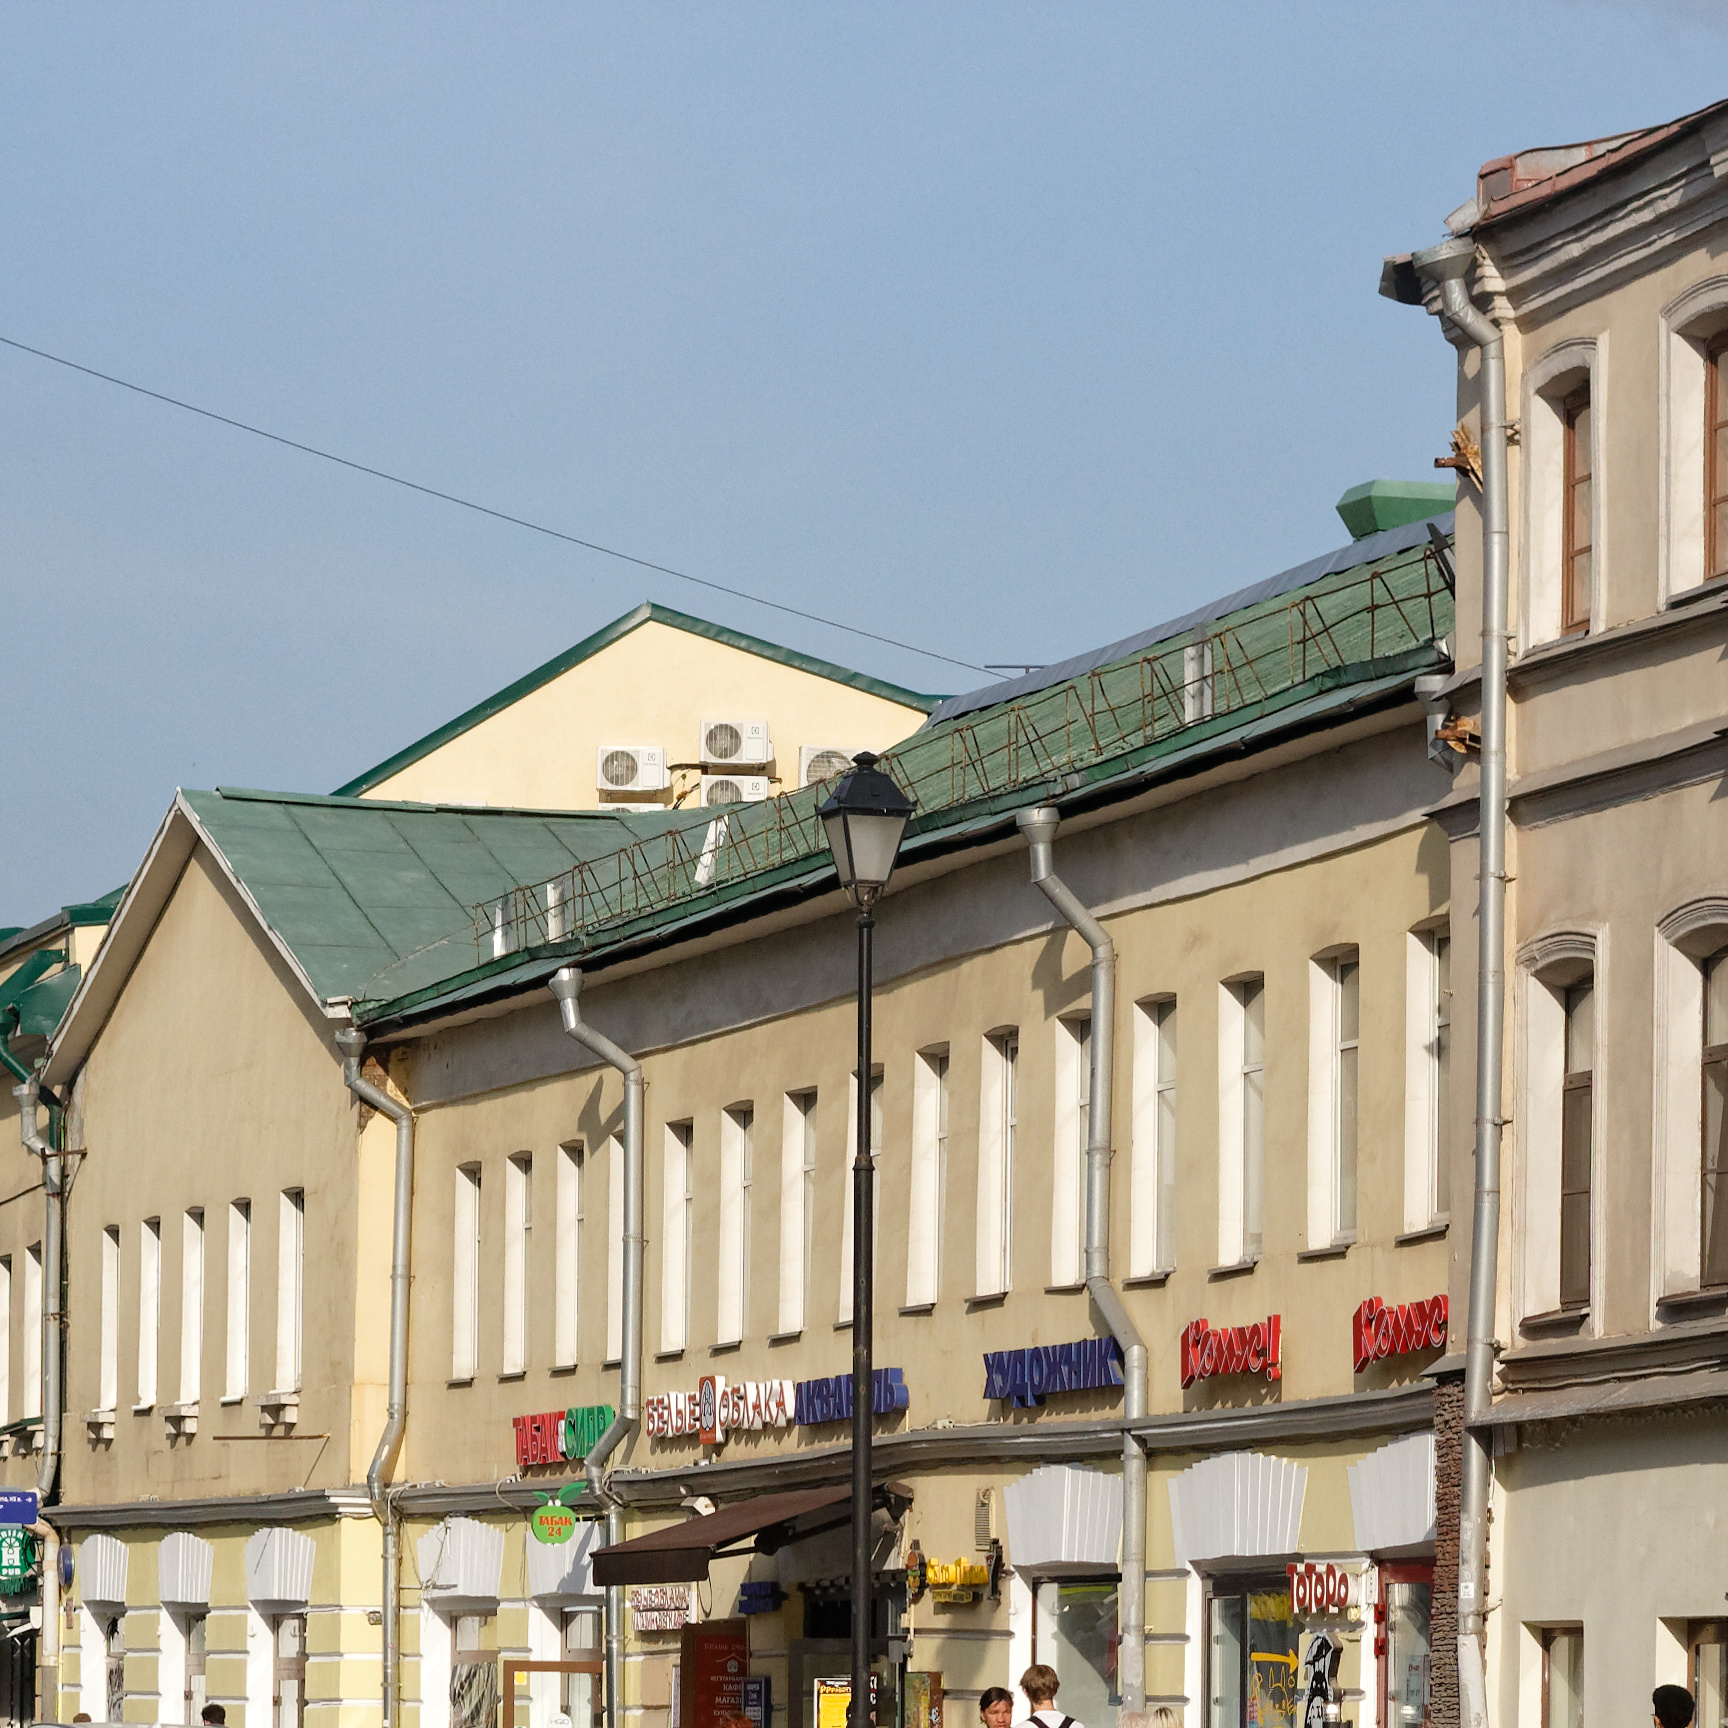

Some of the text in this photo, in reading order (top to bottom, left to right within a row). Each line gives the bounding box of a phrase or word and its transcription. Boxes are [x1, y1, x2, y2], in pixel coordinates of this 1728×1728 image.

[794, 1368, 907, 1426] АКВАРЛЬ
[983, 1336, 1124, 1408] ХУДОЖНИК
[645, 1379, 793, 1438] БЕЛЫЕ ОБЛАКА
[513, 1411, 565, 1466] ТАБАК
[538, 1514, 572, 1527] ТАБАК
[547, 1526, 562, 1537] 24
[2, 1567, 21, 1576] PUB
